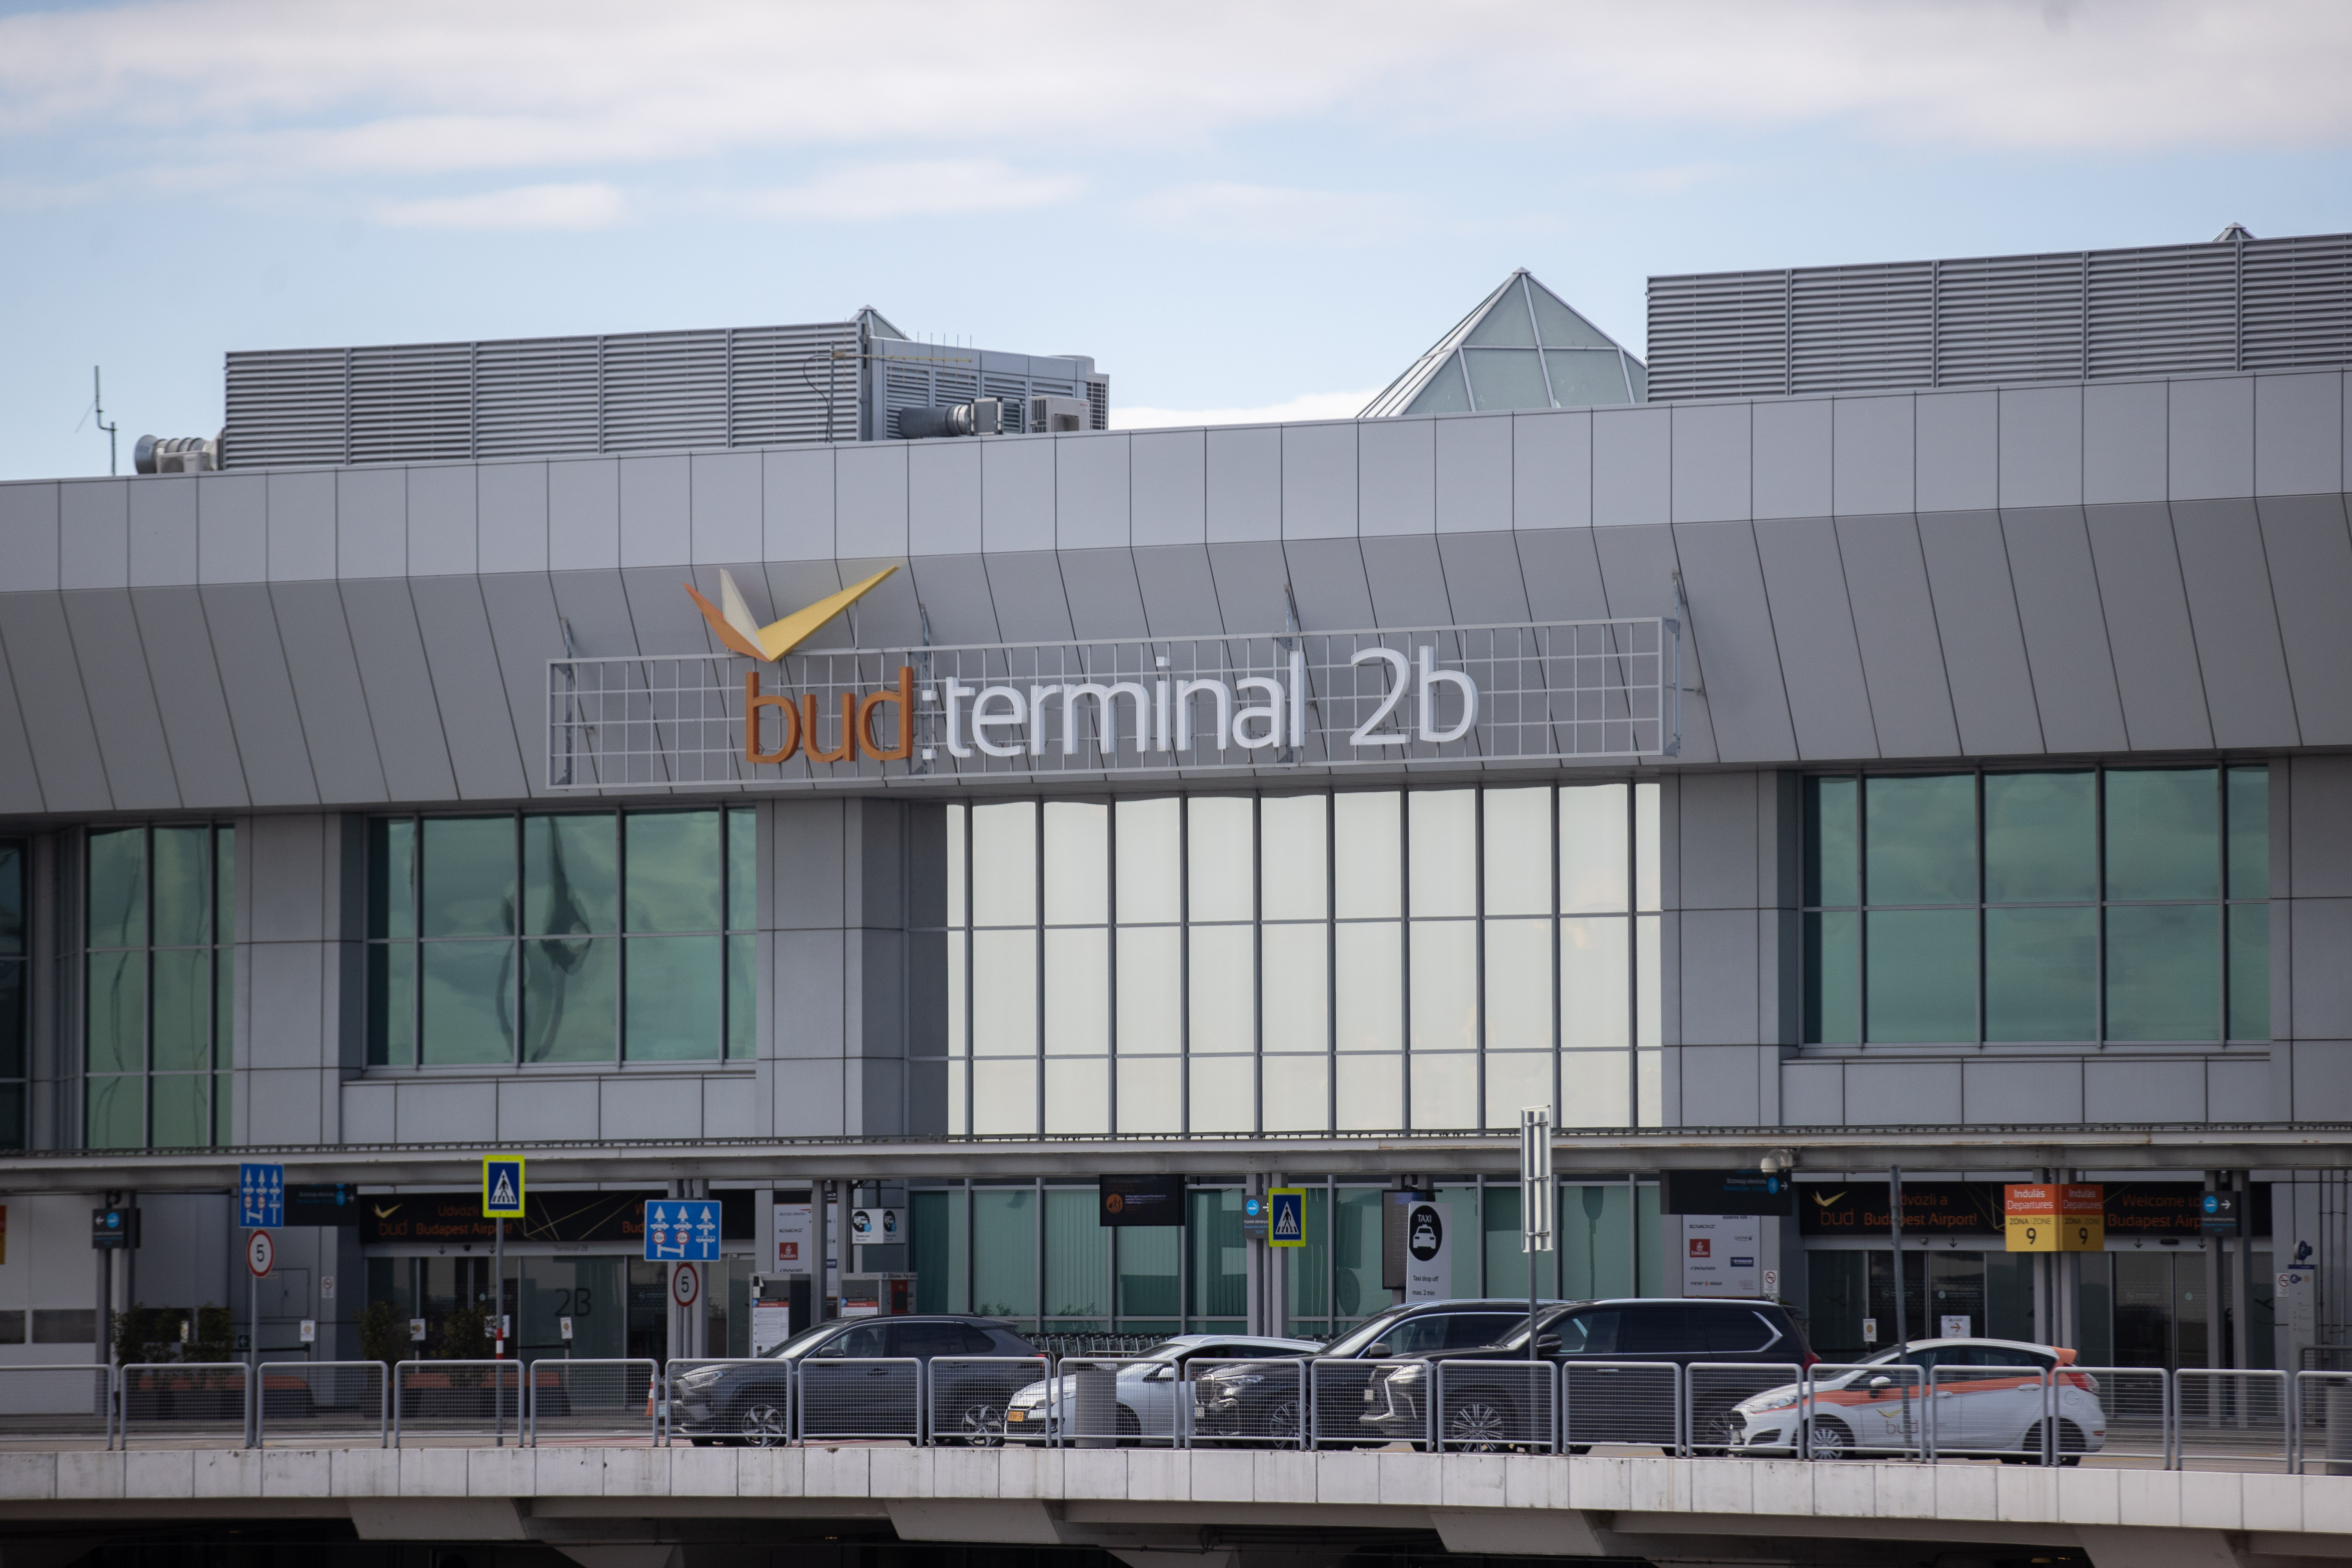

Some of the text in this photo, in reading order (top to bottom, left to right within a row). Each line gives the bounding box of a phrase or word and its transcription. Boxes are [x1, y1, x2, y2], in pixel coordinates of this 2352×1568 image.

[1350, 646, 1479, 745] 2b
[1940, 1195, 1948, 1205] a
[2013, 1188, 2046, 1198] Indulás
[2069, 1188, 2096, 1198] Indulás
[2122, 1194, 2185, 1207] Welcome
[2007, 1200, 2053, 1211] Departures
[2063, 1199, 2102, 1210] Departures
[1417, 1214, 1432, 1223] TAXI
[1820, 1208, 1854, 1225] bud
[1929, 1213, 1977, 1228] Airport!
[2108, 1214, 2171, 1229] Budapest
[379, 1219, 408, 1236] bud
[416, 1222, 469, 1237] Budapest
[2027, 1228, 2036, 1244] 9
[2079, 1228, 2088, 1244] 9
[257, 1244, 265, 1262] 5
[681, 1276, 689, 1292] 5
[554, 1288, 591, 1317] 2B
